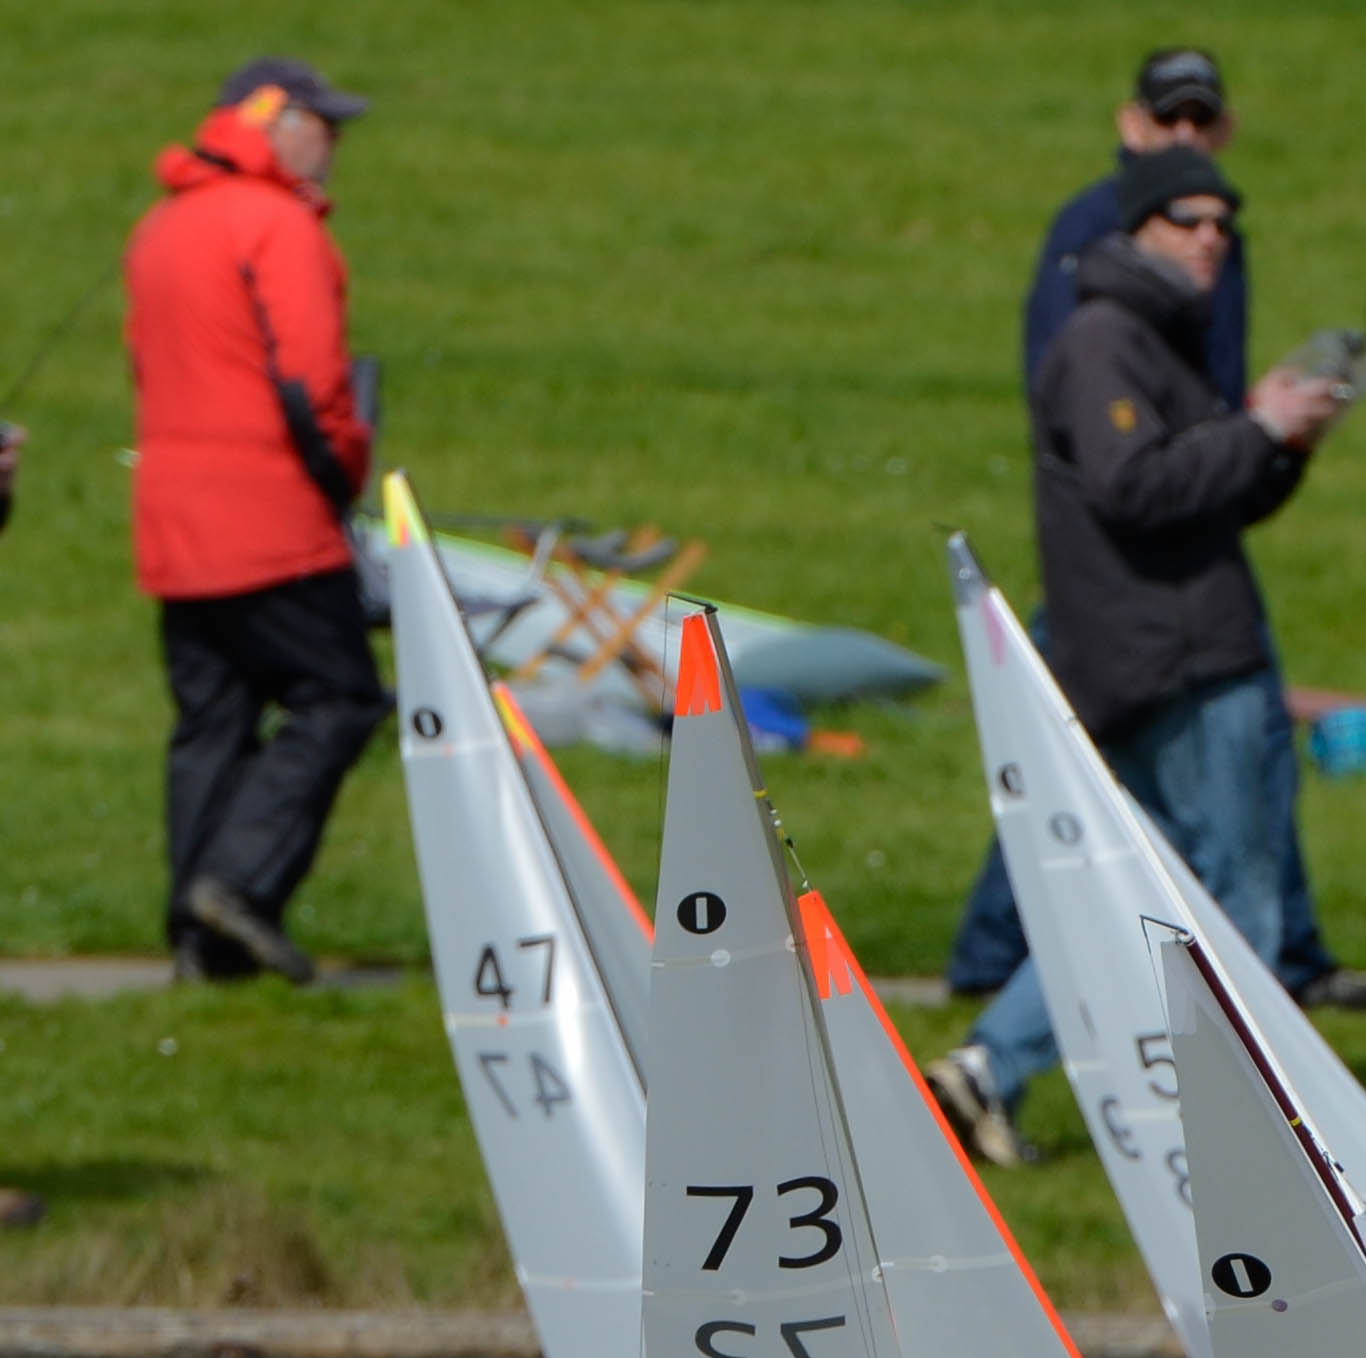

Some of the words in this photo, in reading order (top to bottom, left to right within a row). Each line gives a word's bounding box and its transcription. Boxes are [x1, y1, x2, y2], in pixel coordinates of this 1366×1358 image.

[475, 932, 557, 1009] 47
[1134, 1032, 1181, 1099] 5
[686, 1176, 843, 1271] 73
